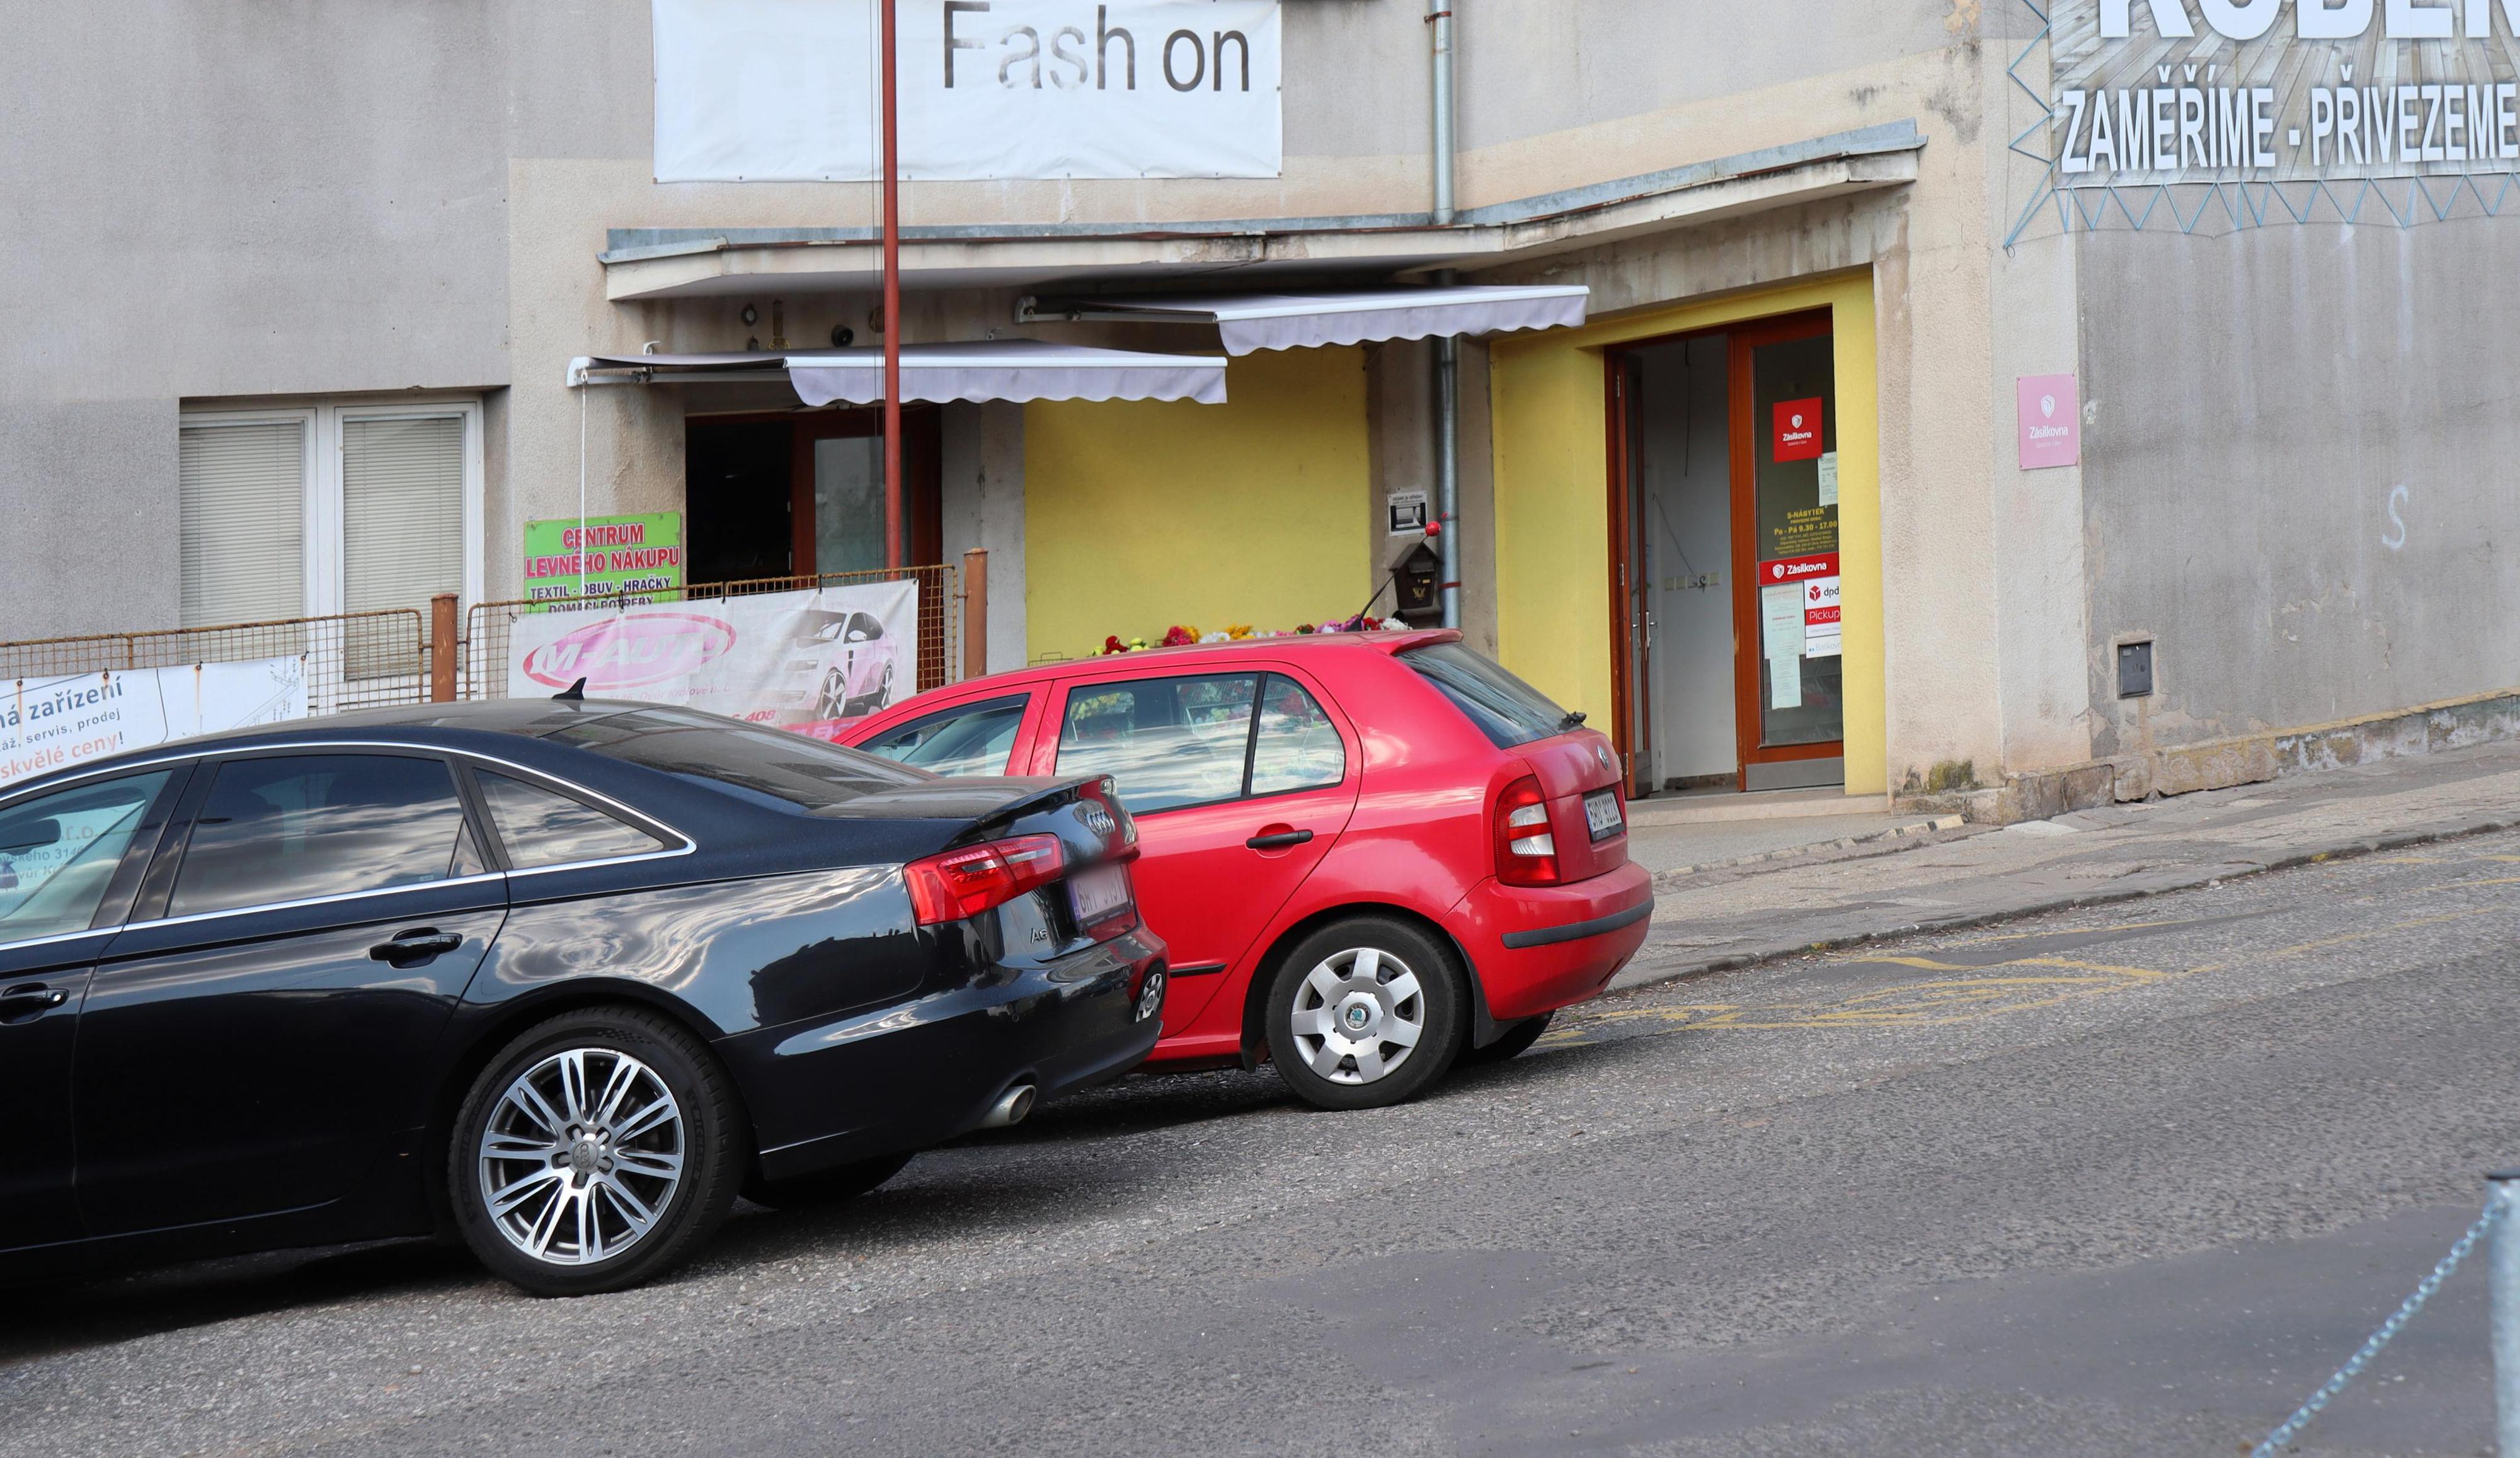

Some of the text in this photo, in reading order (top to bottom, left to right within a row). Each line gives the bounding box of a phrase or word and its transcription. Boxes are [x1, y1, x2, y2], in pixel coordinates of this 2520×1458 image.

[2061, 64, 2276, 173] ZAMĚŘÍME
[2310, 64, 2519, 166] PŘIVEZEME
[1782, 431, 1812, 441] Zásilkovna
[2029, 425, 2068, 439] Zásilkovna
[1787, 507, 1824, 519] S-NÁBYTEK
[1799, 523, 1814, 532] 9.30
[1819, 520, 1838, 530] 17.00
[2382, 484, 2408, 550] S
[562, 523, 644, 549] CENTRUM
[525, 545, 680, 579] LEVNÉHO NÁKUPU
[1787, 562, 1827, 574] Zásilkovna
[530, 586, 570, 600] TEXTIL
[580, 581, 614, 595] OBUV
[624, 574, 671, 592] HRAČKY
[1823, 585, 1840, 598] dpd
[1809, 609, 1840, 621] Pickup
[29, 675, 123, 720] zařízení
[0, 708, 121, 752] áž, servis, prodej
[0, 731, 124, 779] skvělé ceny!
